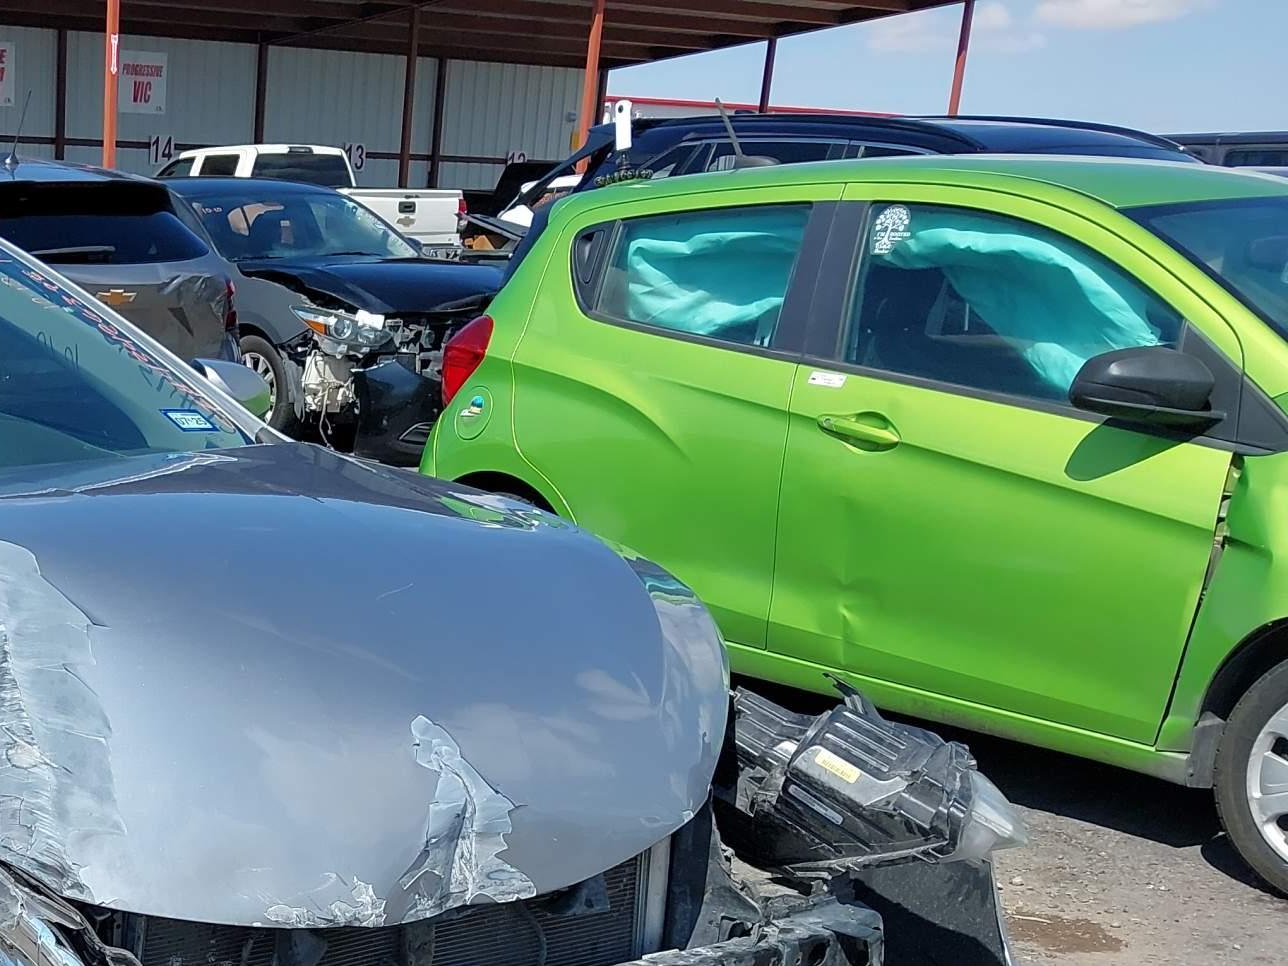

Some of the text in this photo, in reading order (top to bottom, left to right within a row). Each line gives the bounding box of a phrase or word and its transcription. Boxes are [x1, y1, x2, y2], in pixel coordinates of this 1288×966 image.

[122, 63, 163, 77] PROGRESSIVE
[132, 79, 152, 104] VIC
[152, 135, 173, 163] 14
[344, 144, 364, 170] 13
